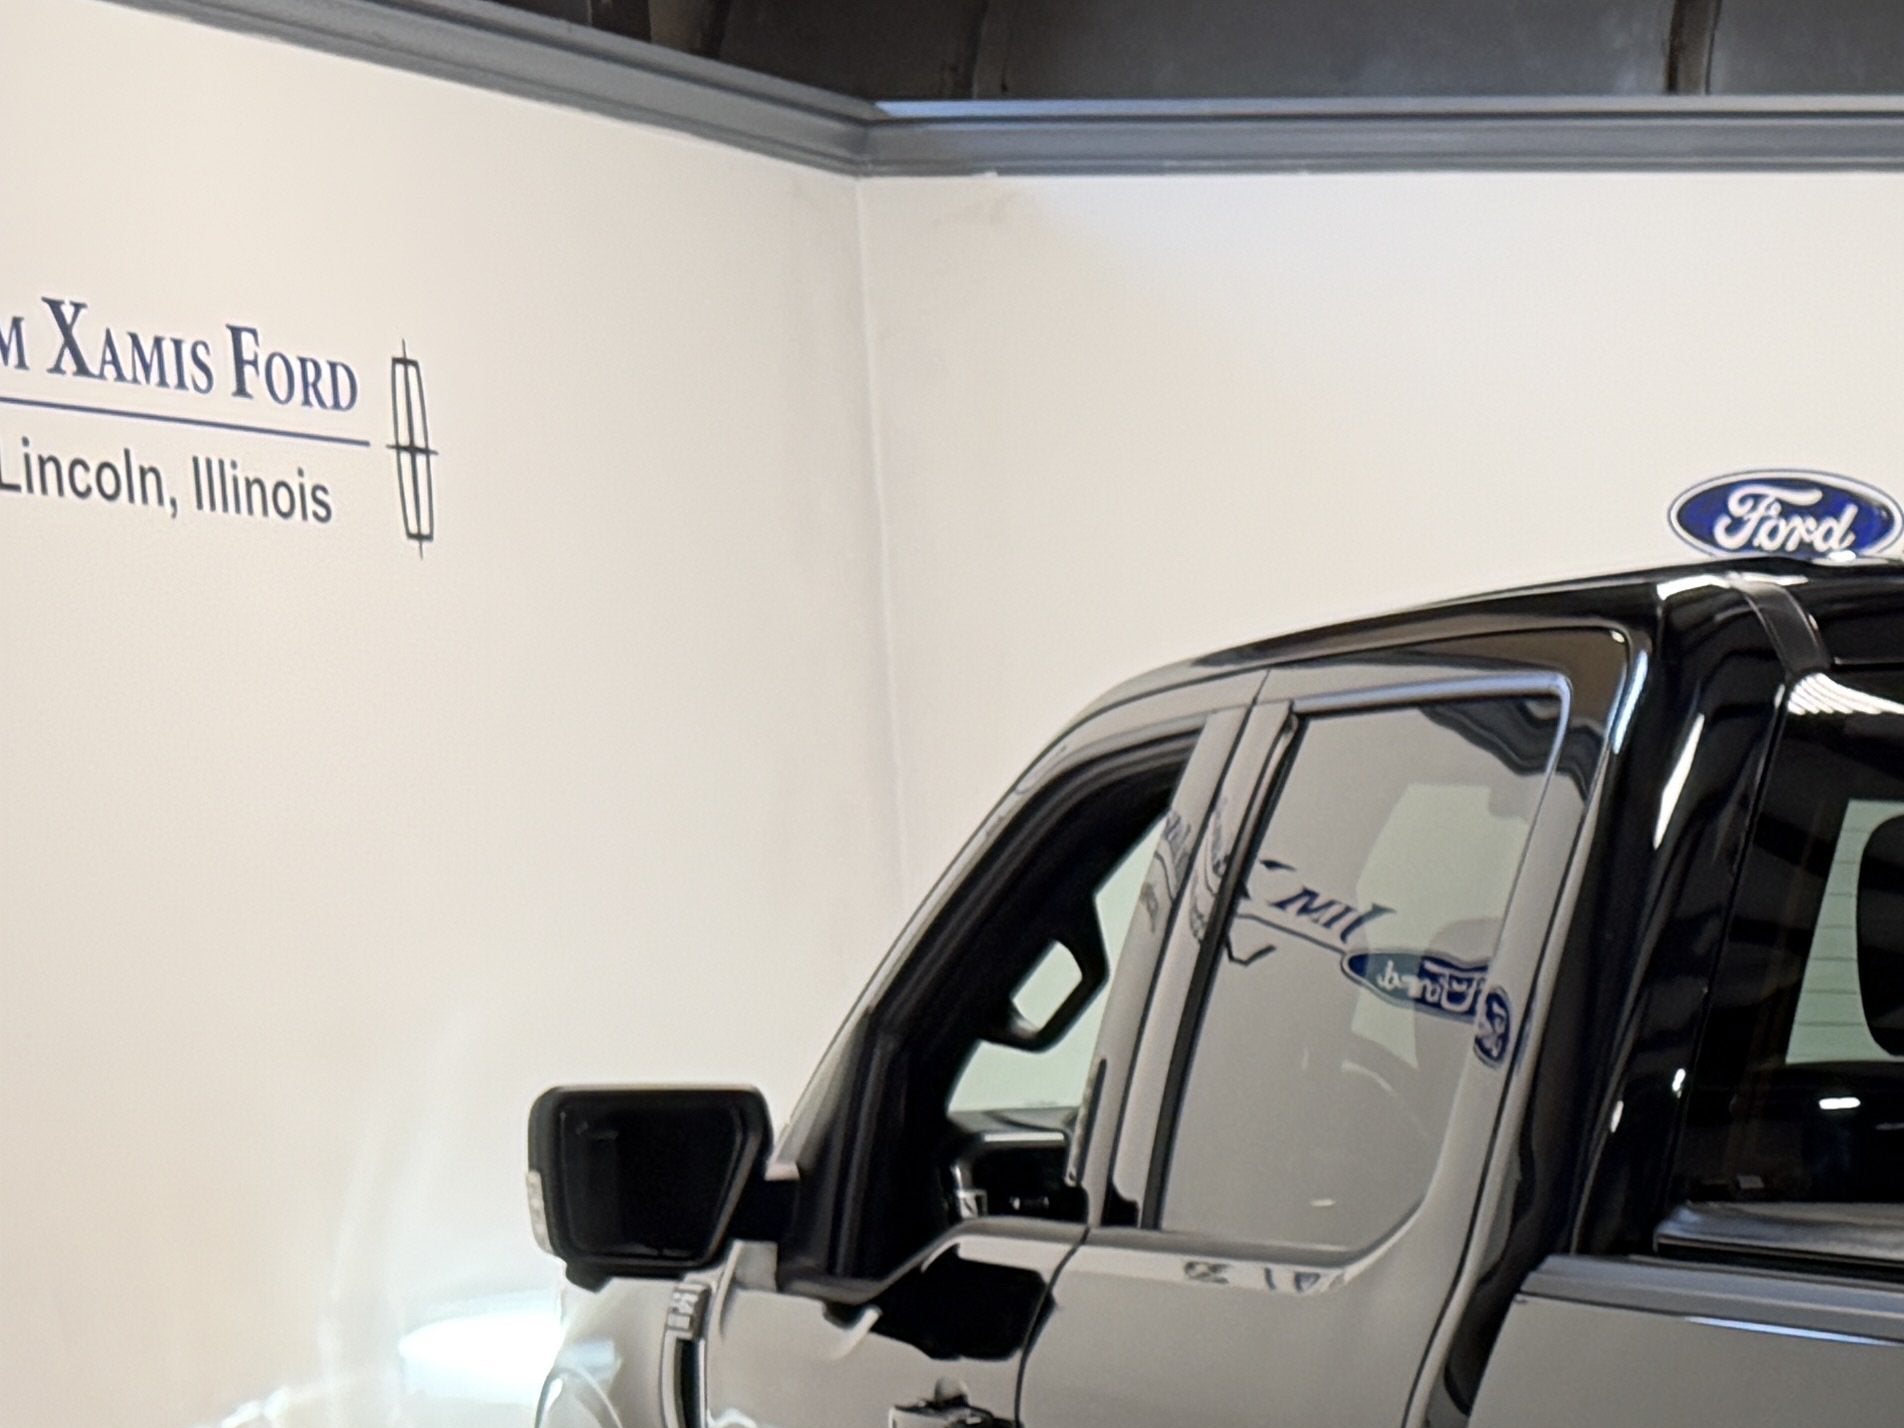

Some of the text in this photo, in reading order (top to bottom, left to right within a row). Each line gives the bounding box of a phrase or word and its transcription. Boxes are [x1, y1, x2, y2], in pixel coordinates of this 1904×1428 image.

[42, 296, 215, 395] XAMIS
[226, 323, 358, 412] FORD
[192, 455, 333, 524] Illinois
[1713, 483, 1859, 552] Ford
